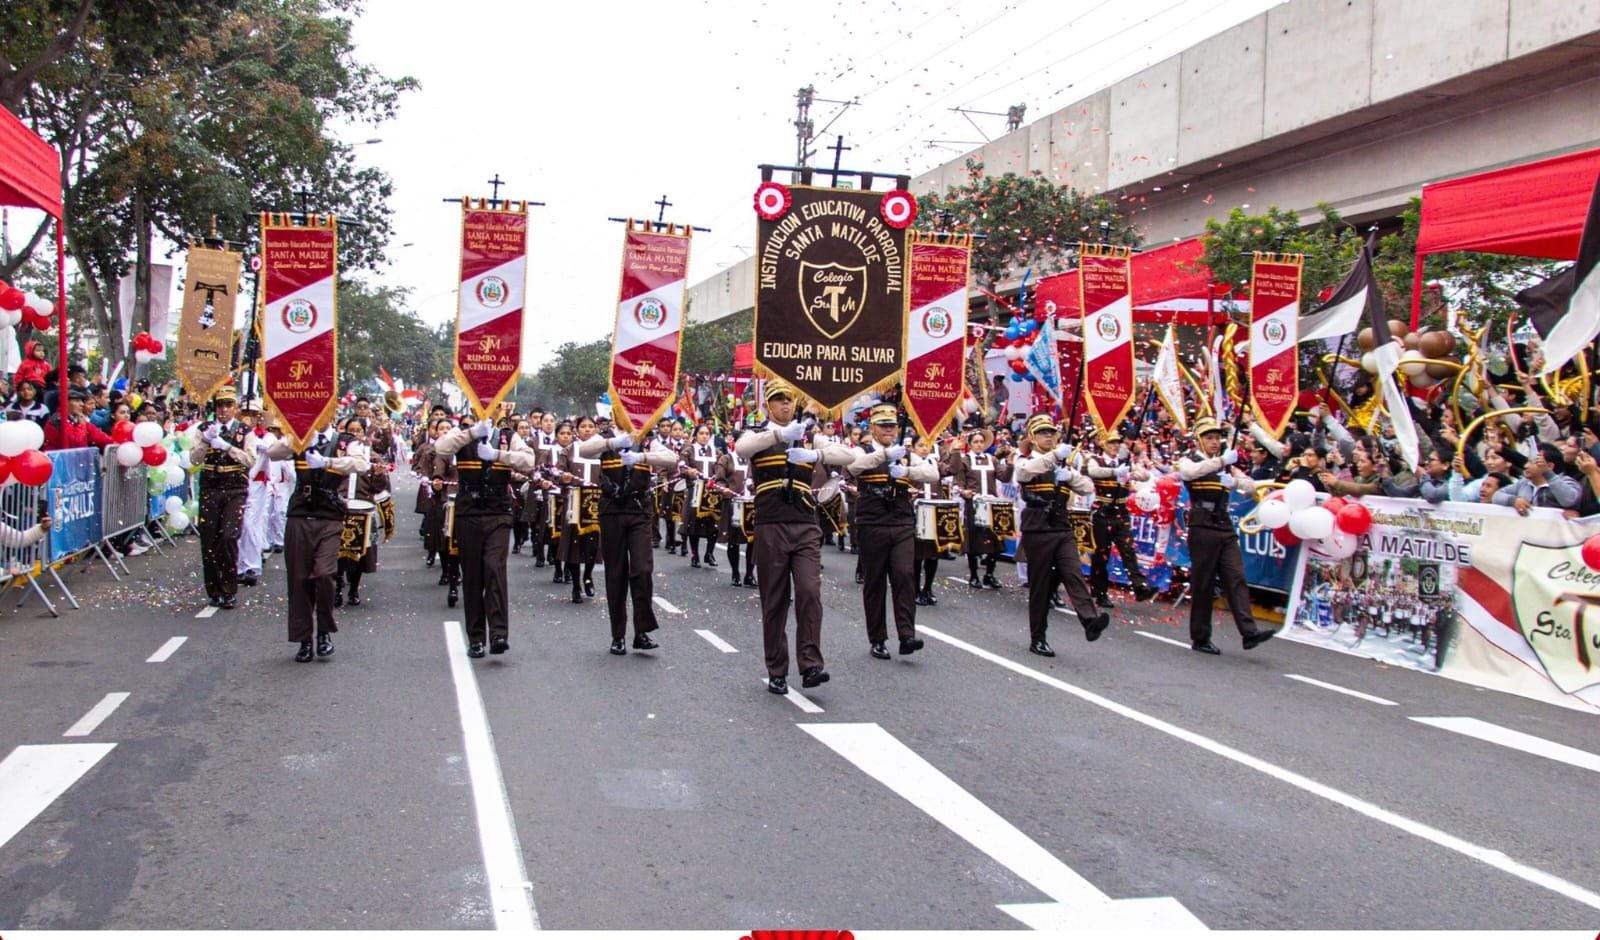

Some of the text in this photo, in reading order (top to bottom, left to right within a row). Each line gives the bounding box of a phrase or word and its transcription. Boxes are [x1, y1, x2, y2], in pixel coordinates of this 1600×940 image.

[467, 231, 521, 242] SANTA MATILDE
[761, 200, 902, 295] INSTITUCION EDUCATIVA PARROQUIAL
[786, 222, 881, 264] SANTA MATILDE
[270, 251, 328, 260] SANTA MATILDE
[629, 252, 681, 264] SANTA MATILDE
[915, 264, 963, 273] SANTA MATILDE
[813, 270, 854, 286] Colegio
[763, 342, 895, 363] EDUCAR PARA SALVAR
[467, 354, 496, 362] RUMBO
[463, 363, 515, 371] BICENTENARIO
[796, 365, 864, 383] SAN LUIS
[276, 382, 309, 390] RUMBO
[622, 379, 651, 388] RUMBO
[913, 381, 940, 389] RUMBO
[1093, 382, 1115, 390] RUMBO
[273, 391, 330, 399] BICENTENARIO
[618, 388, 669, 397] BICENTENARIO
[910, 389, 957, 398] BICENTENARIO
[1381, 535, 1470, 563] MATILDE
